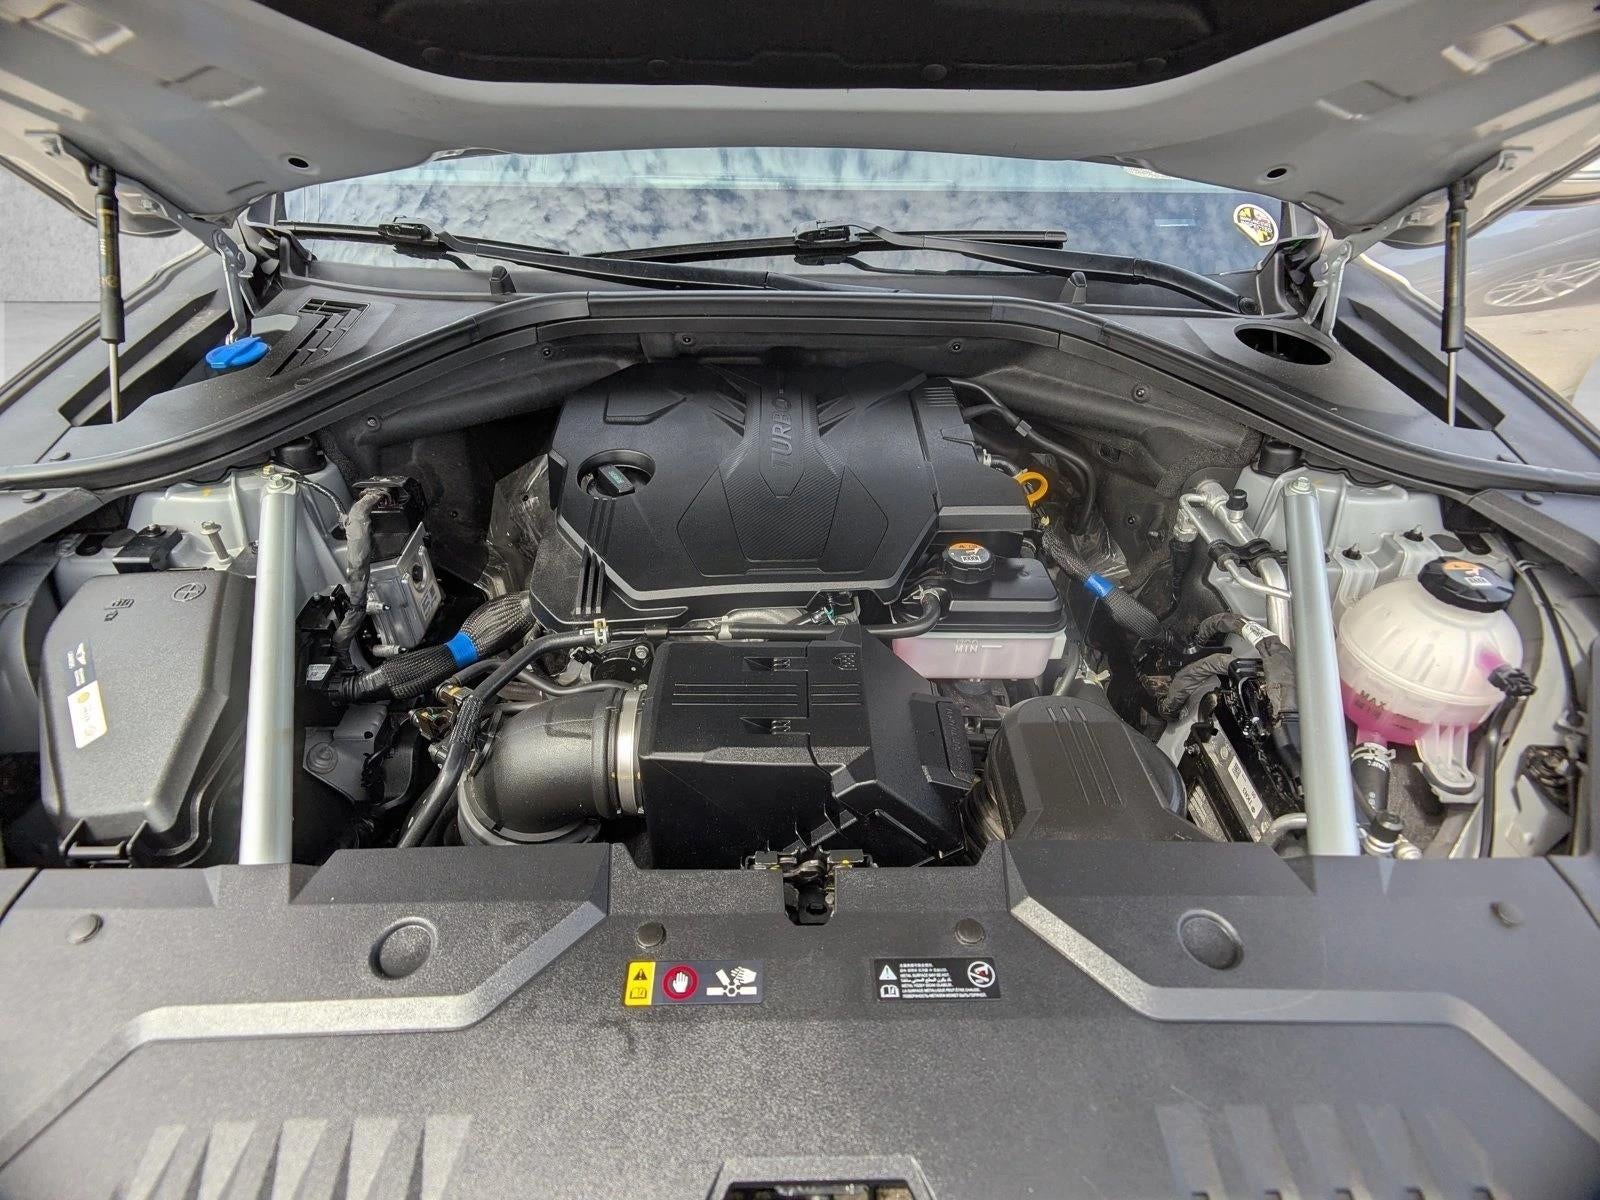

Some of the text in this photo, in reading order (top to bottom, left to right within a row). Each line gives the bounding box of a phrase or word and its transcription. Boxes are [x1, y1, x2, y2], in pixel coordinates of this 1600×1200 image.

[771, 398, 793, 469] TURBO
[954, 644, 978, 654] MIN
[1360, 689, 1386, 711] MAX
